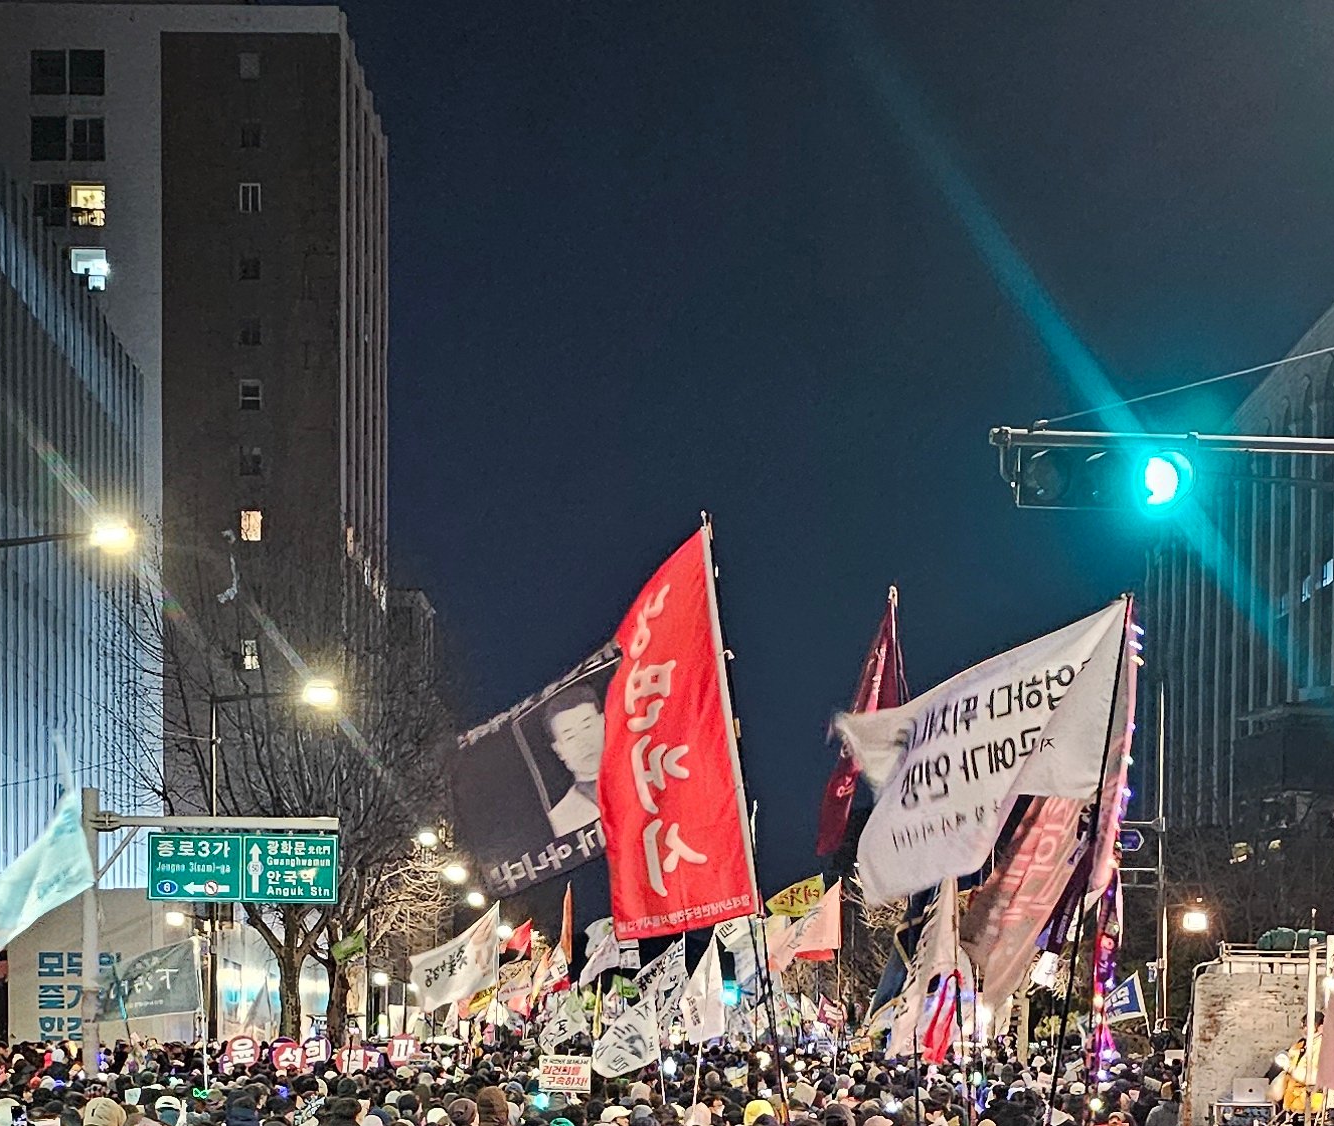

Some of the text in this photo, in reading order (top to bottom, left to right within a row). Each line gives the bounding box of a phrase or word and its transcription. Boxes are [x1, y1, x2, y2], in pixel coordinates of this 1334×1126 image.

[156, 839, 231, 858] 종로3가
[267, 840, 306, 856] 광화문
[156, 860, 186, 873] Jongno
[266, 855, 331, 868] Gwanghwamun
[266, 870, 315, 886] 안국역
[266, 885, 331, 898] Anguk Stn
